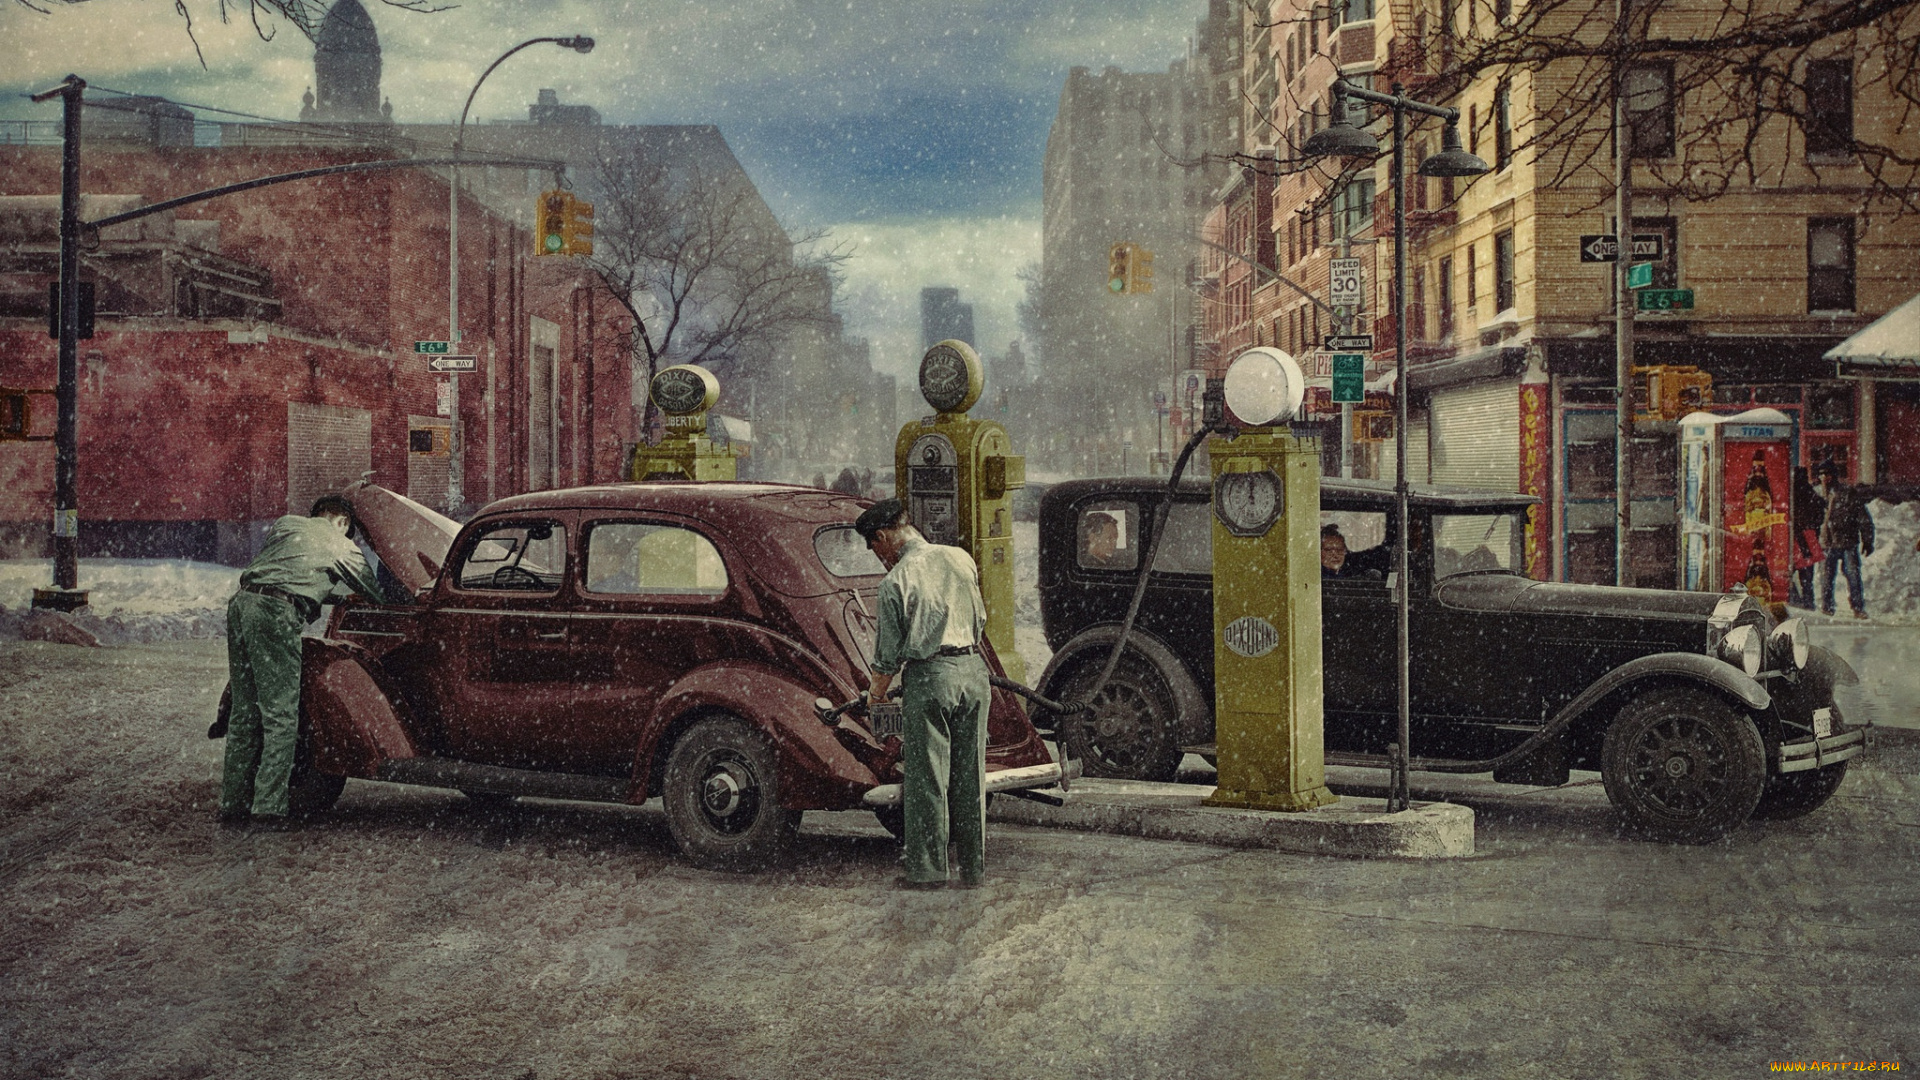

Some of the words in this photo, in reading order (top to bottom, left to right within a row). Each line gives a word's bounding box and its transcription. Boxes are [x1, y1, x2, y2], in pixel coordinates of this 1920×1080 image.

[1592, 243, 1617, 254] ONE
[1632, 242, 1652, 254] AY
[1332, 261, 1359, 269] SPEED
[1334, 269, 1356, 277] LIMIT
[1333, 277, 1358, 293] 30
[1644, 293, 1654, 308] E
[1658, 293, 1670, 308] 6
[420, 342, 427, 352] E
[428, 343, 435, 352] 6
[660, 371, 695, 384] DIXIE
[1741, 427, 1774, 437] TITAN
